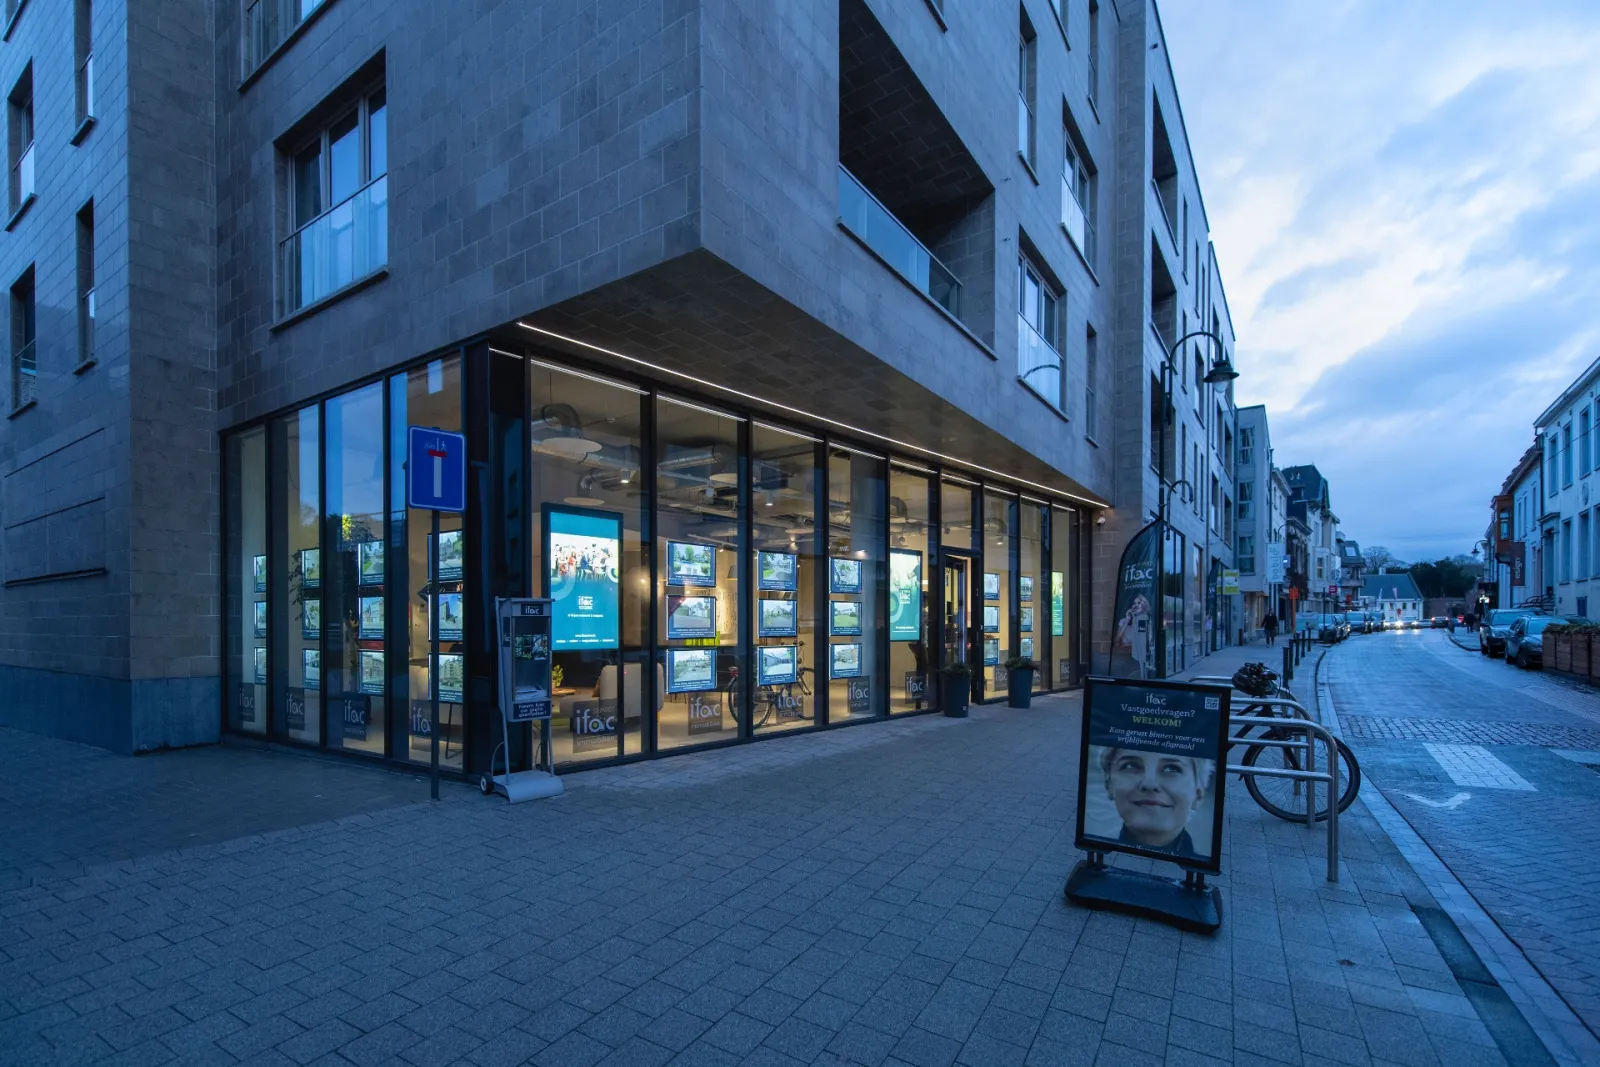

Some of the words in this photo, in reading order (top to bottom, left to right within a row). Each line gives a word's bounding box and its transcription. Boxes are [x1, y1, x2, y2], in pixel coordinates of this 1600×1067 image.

[1124, 564, 1153, 583] ifac
[525, 606, 539, 615] ifac
[849, 682, 869, 699] ifac
[906, 676, 923, 692] ifac
[239, 688, 255, 708] ifac
[286, 693, 303, 715] ifac
[778, 694, 803, 709] ifac
[1146, 693, 1166, 705] ifac
[344, 700, 365, 724] ifac
[690, 697, 721, 719] ifac
[1121, 704, 1195, 718] Vastgoedvragen?
[412, 707, 431, 733] ifa
[576, 709, 615, 734] ifac
[1132, 715, 1182, 728] WELKOM!
[1109, 726, 1125, 734] Kom
[1126, 730, 1148, 738] gerust
[1148, 730, 1173, 740] binnen
[1174, 734, 1190, 742] voor
[1191, 736, 1205, 744] een
[1117, 736, 1160, 747] vrijblijvende
[1161, 739, 1195, 750] afspraak!
